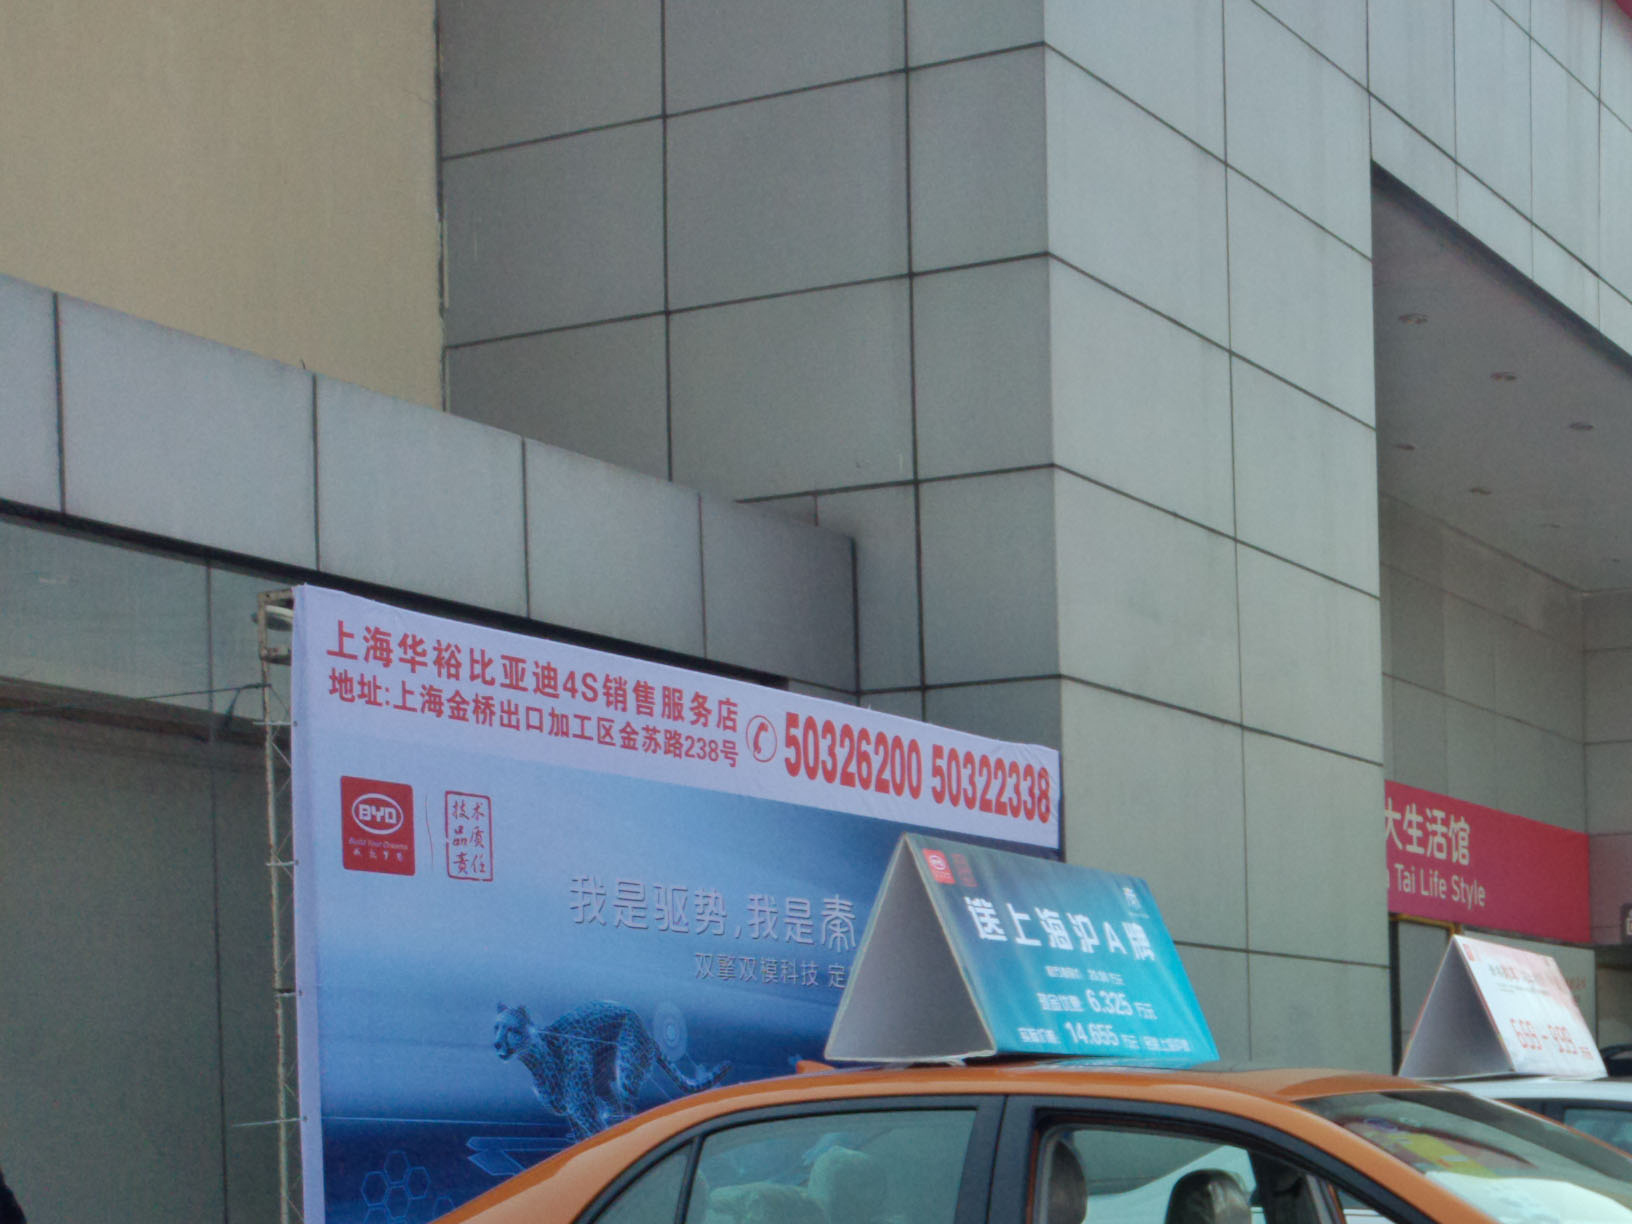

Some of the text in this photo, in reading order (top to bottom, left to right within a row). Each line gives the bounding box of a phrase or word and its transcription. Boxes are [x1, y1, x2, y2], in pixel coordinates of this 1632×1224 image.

[326, 619, 739, 732] 上海华裕比亚迪4S销售服务店
[784, 711, 1050, 823] 50326200 50322338
[358, 804, 397, 824] BYD
[452, 799, 485, 821] 技术
[453, 825, 485, 849] 品质
[1385, 797, 1470, 866] 大生活馆
[1394, 863, 1486, 911] Tai Life Style
[694, 952, 818, 987] 双擎双模科技
